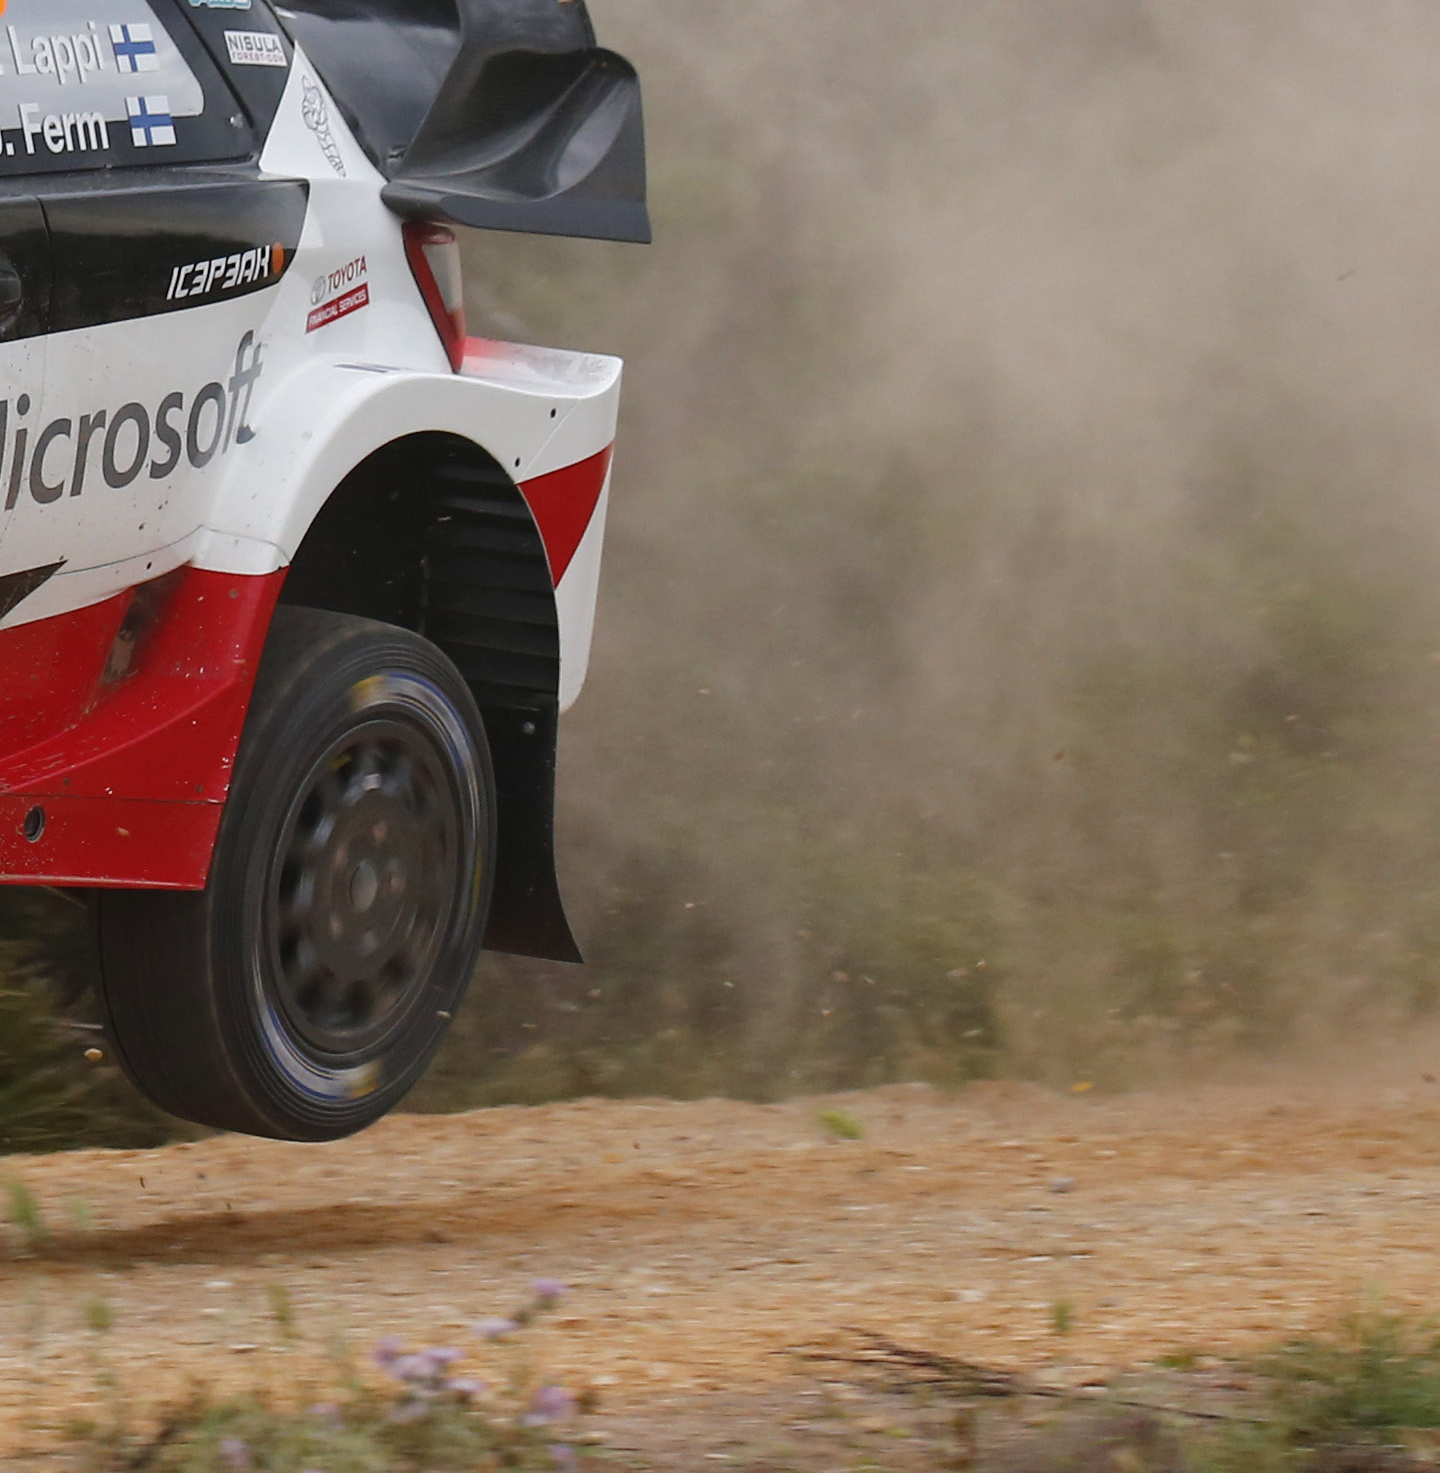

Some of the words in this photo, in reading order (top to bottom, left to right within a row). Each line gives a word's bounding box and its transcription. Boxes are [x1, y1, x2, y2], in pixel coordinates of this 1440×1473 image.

[9, 22, 104, 86] Lappi
[227, 35, 280, 52] NISULA
[19, 102, 110, 155] Ferm
[328, 255, 367, 294] TOYOTA
